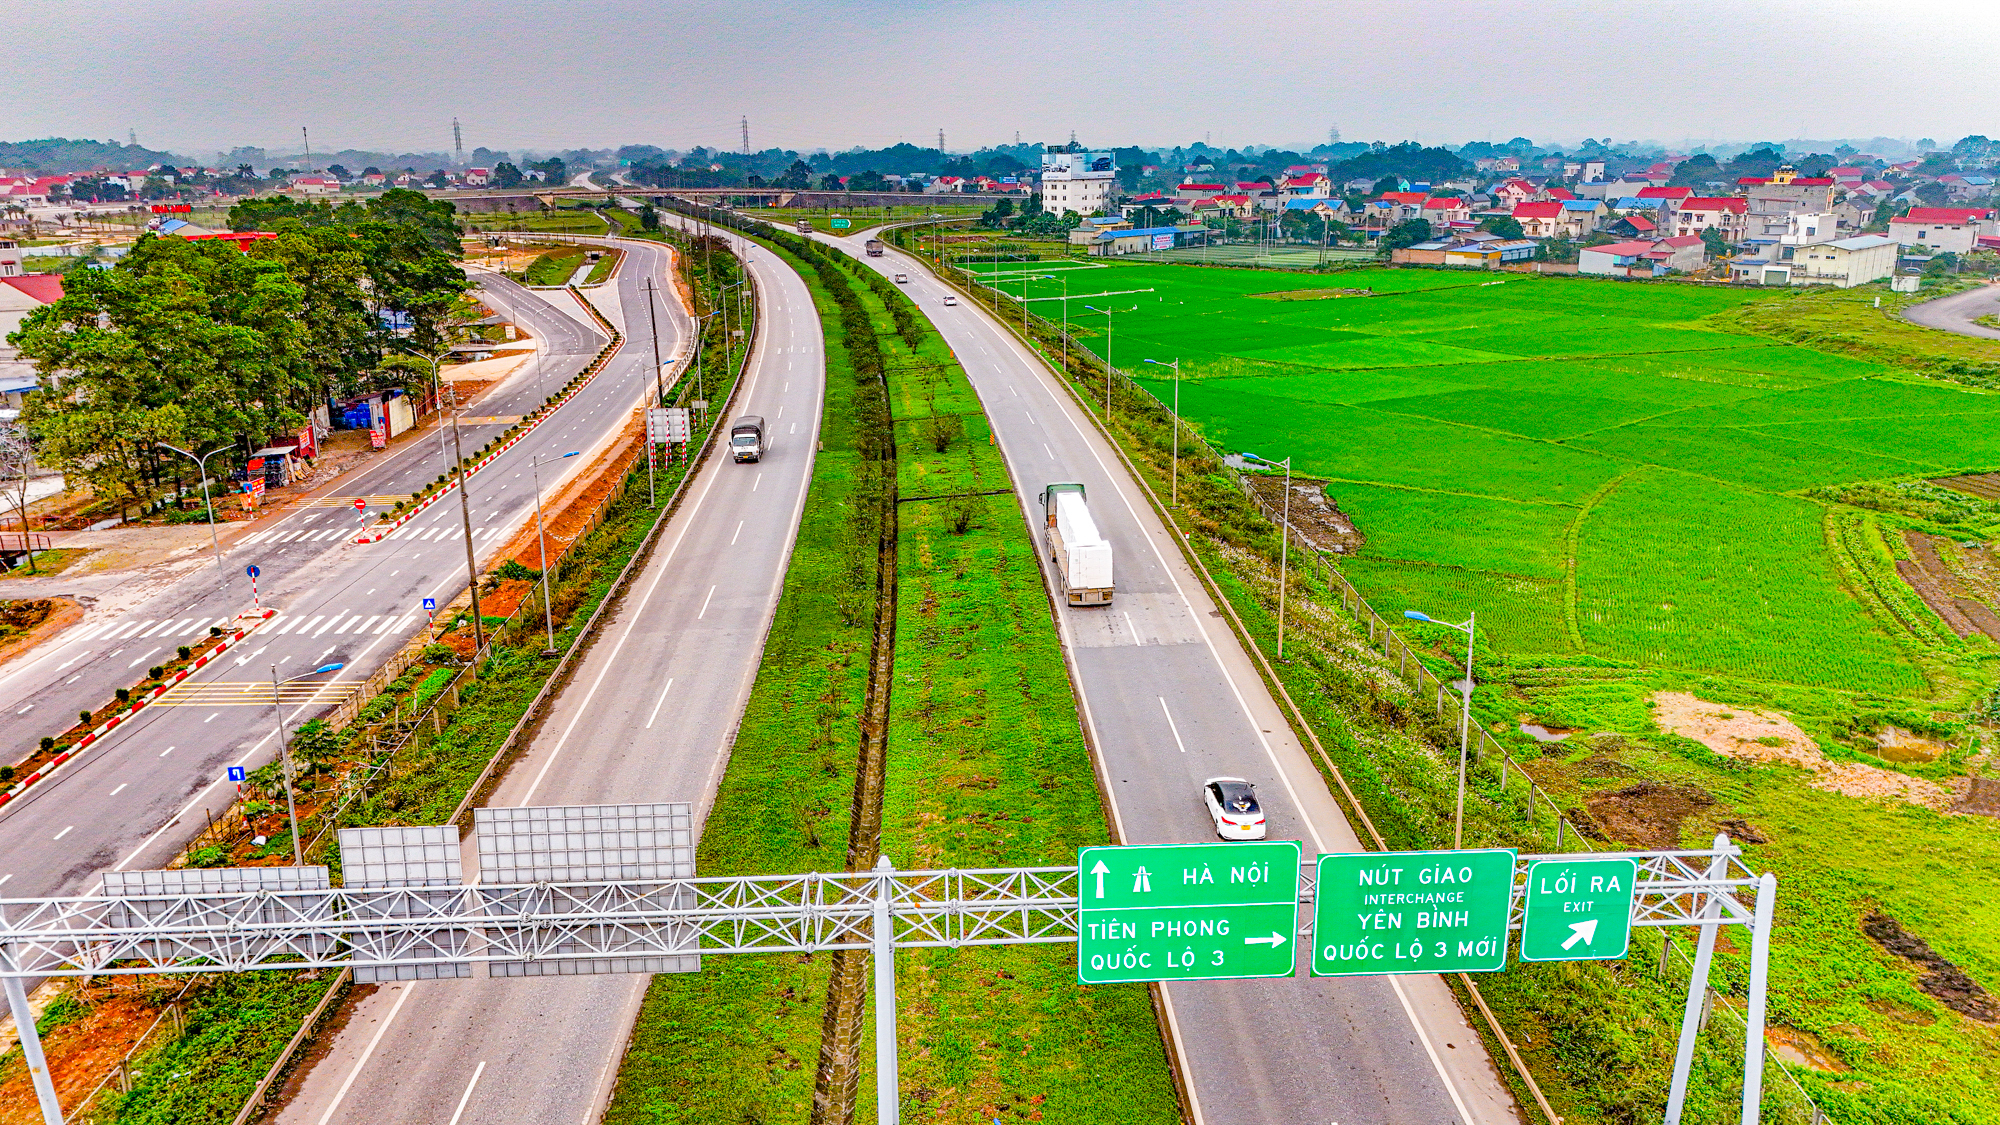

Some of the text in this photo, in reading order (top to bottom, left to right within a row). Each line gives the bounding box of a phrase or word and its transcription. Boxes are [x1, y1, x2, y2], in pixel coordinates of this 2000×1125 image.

[1183, 861, 1269, 888] HÀ NỘI
[1358, 863, 1473, 886] NÚT GIAO
[1540, 867, 1621, 895] LỐI RA
[1364, 891, 1465, 906] INTERCHANGE
[1563, 900, 1594, 913] EXIT
[1088, 918, 1230, 940] TIÊN PHONG
[1357, 903, 1469, 930] YÊN BÌNH
[1091, 944, 1225, 971] QUỐC LỘ 3
[1323, 935, 1497, 963] QUỐC LỘ 3 MỚI
